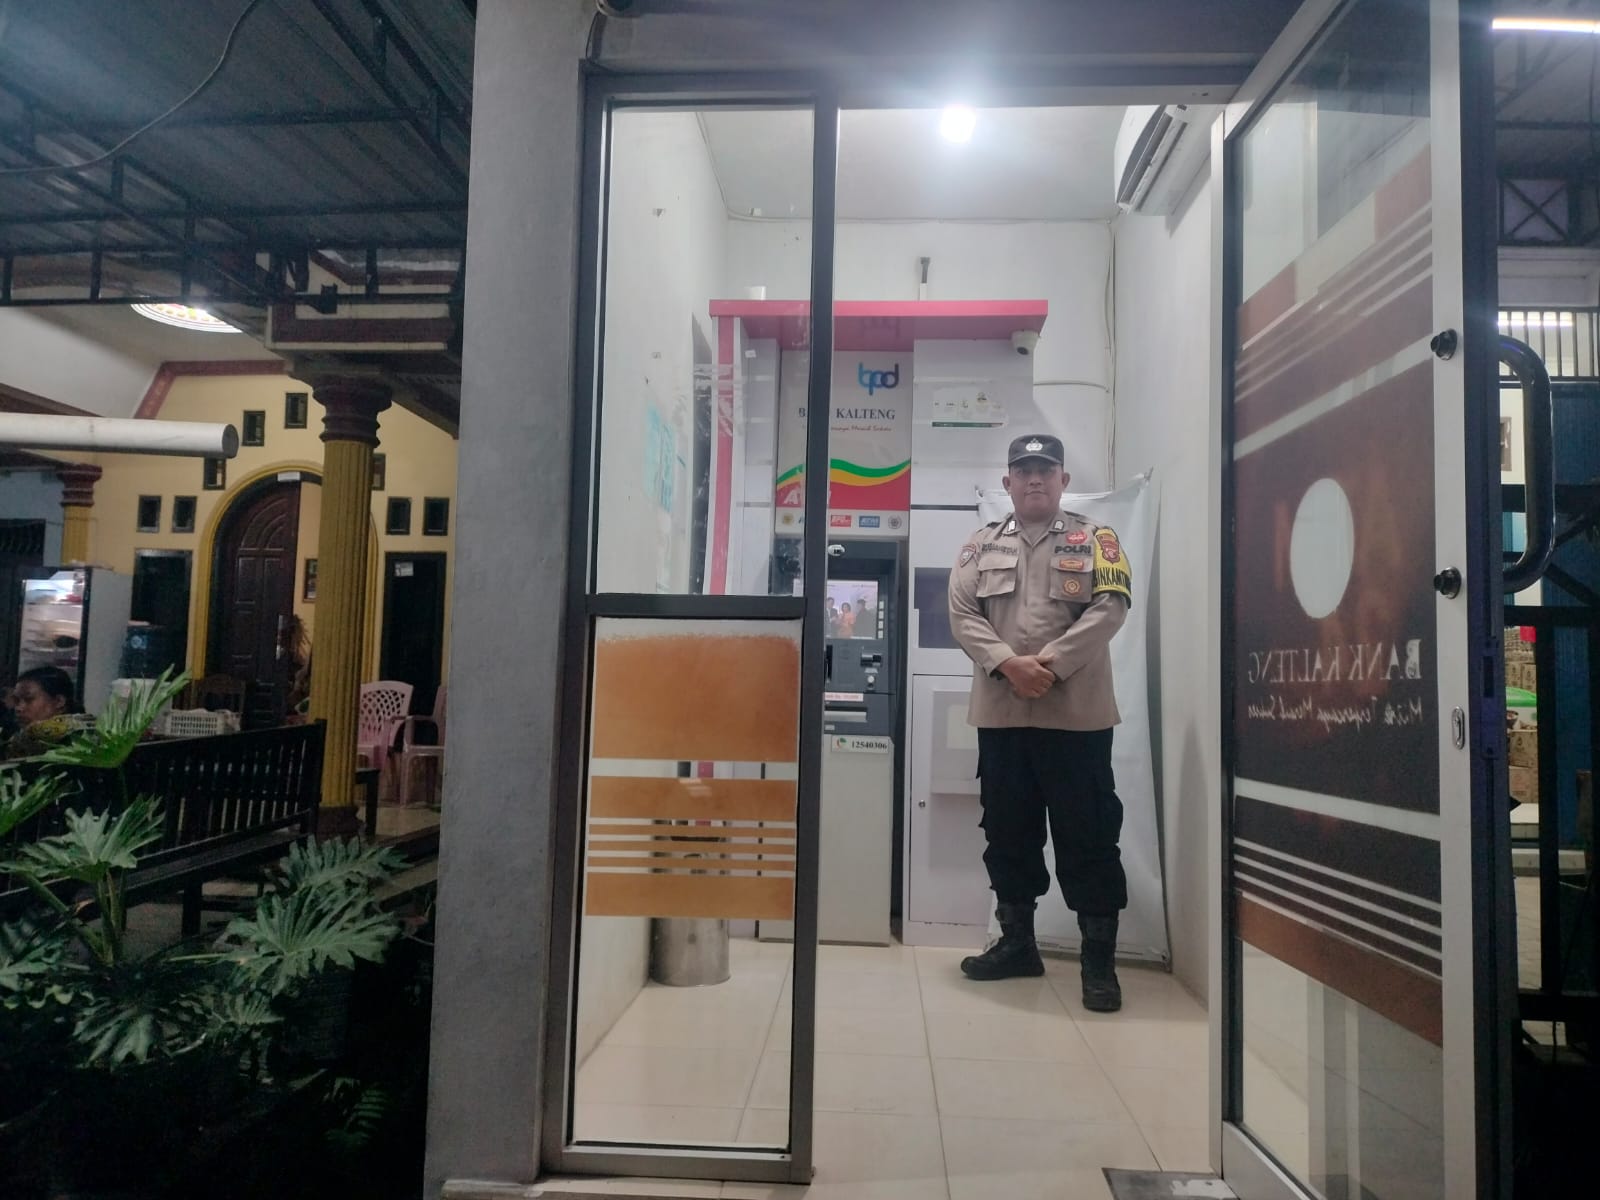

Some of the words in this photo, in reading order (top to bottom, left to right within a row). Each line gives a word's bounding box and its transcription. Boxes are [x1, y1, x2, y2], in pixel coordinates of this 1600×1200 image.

[836, 408, 896, 420] KALTENG
[1055, 545, 1091, 554] POLRI
[852, 740, 888, 750] 12540306
